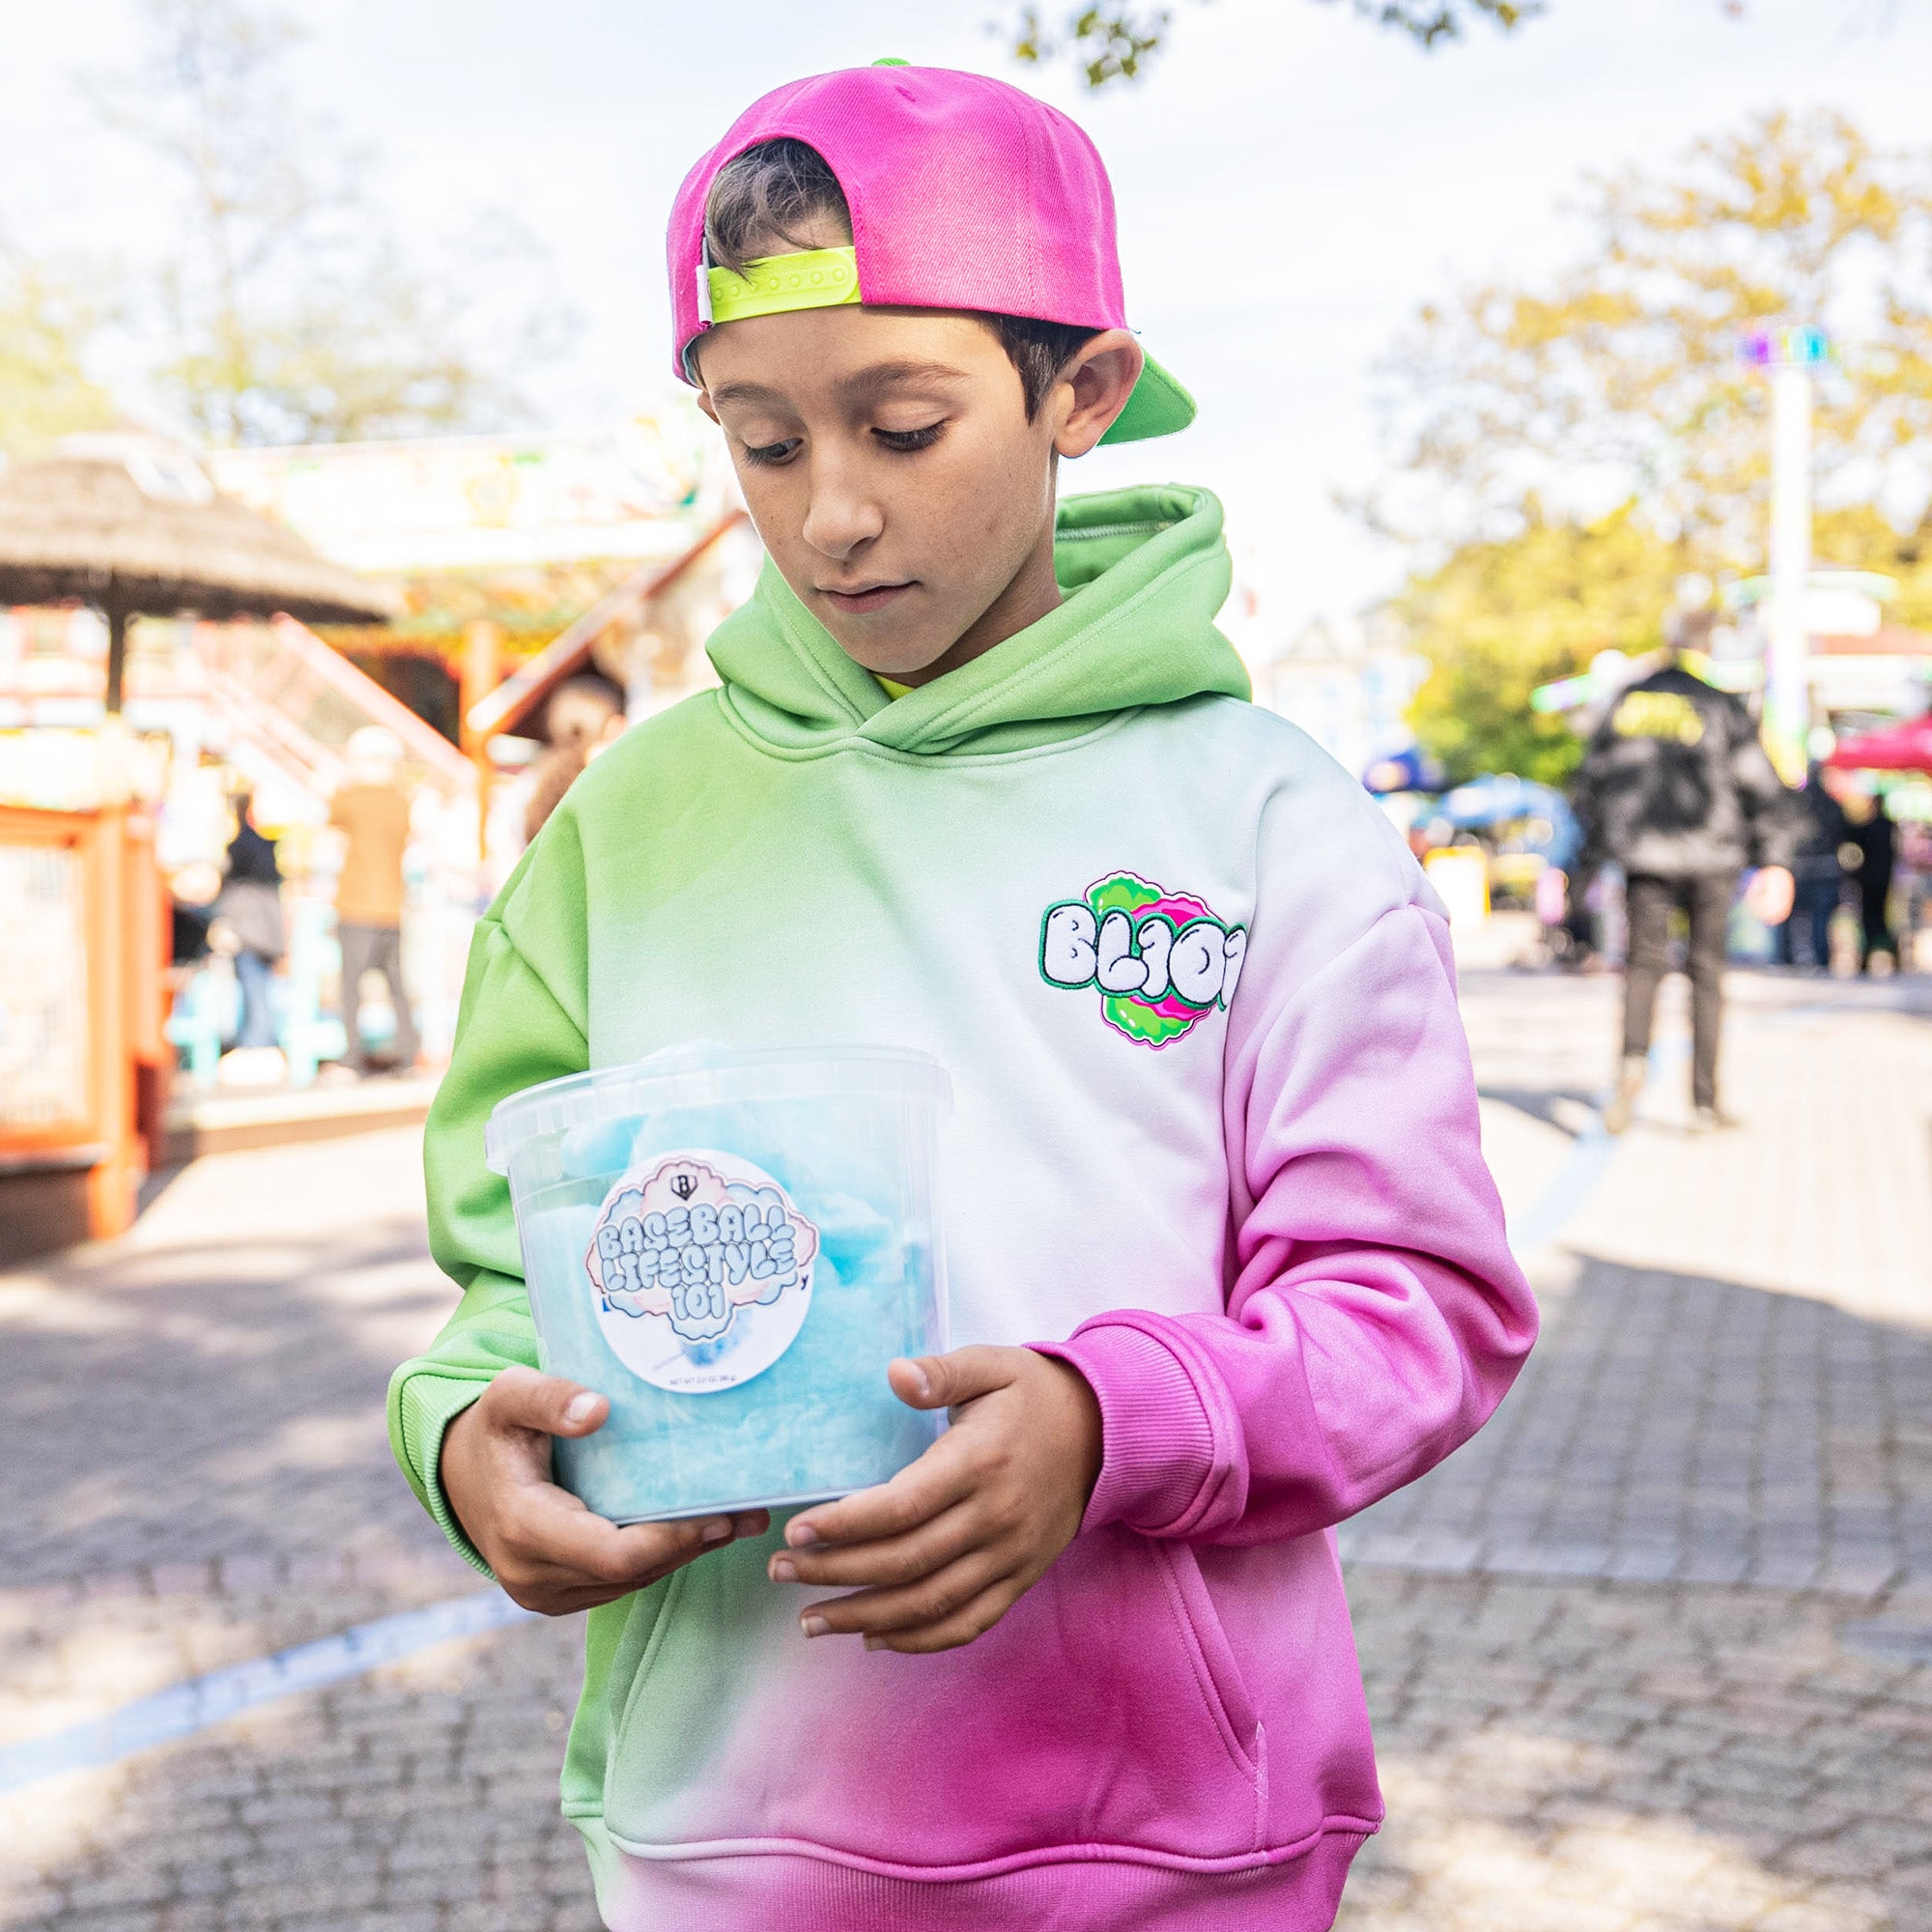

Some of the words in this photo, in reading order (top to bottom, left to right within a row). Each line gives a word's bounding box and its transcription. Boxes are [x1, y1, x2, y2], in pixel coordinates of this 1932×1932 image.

[597, 1203, 796, 1260] BASEBALL
[601, 1237, 797, 1292] LIFESTYLE
[671, 1282, 725, 1321] 101
